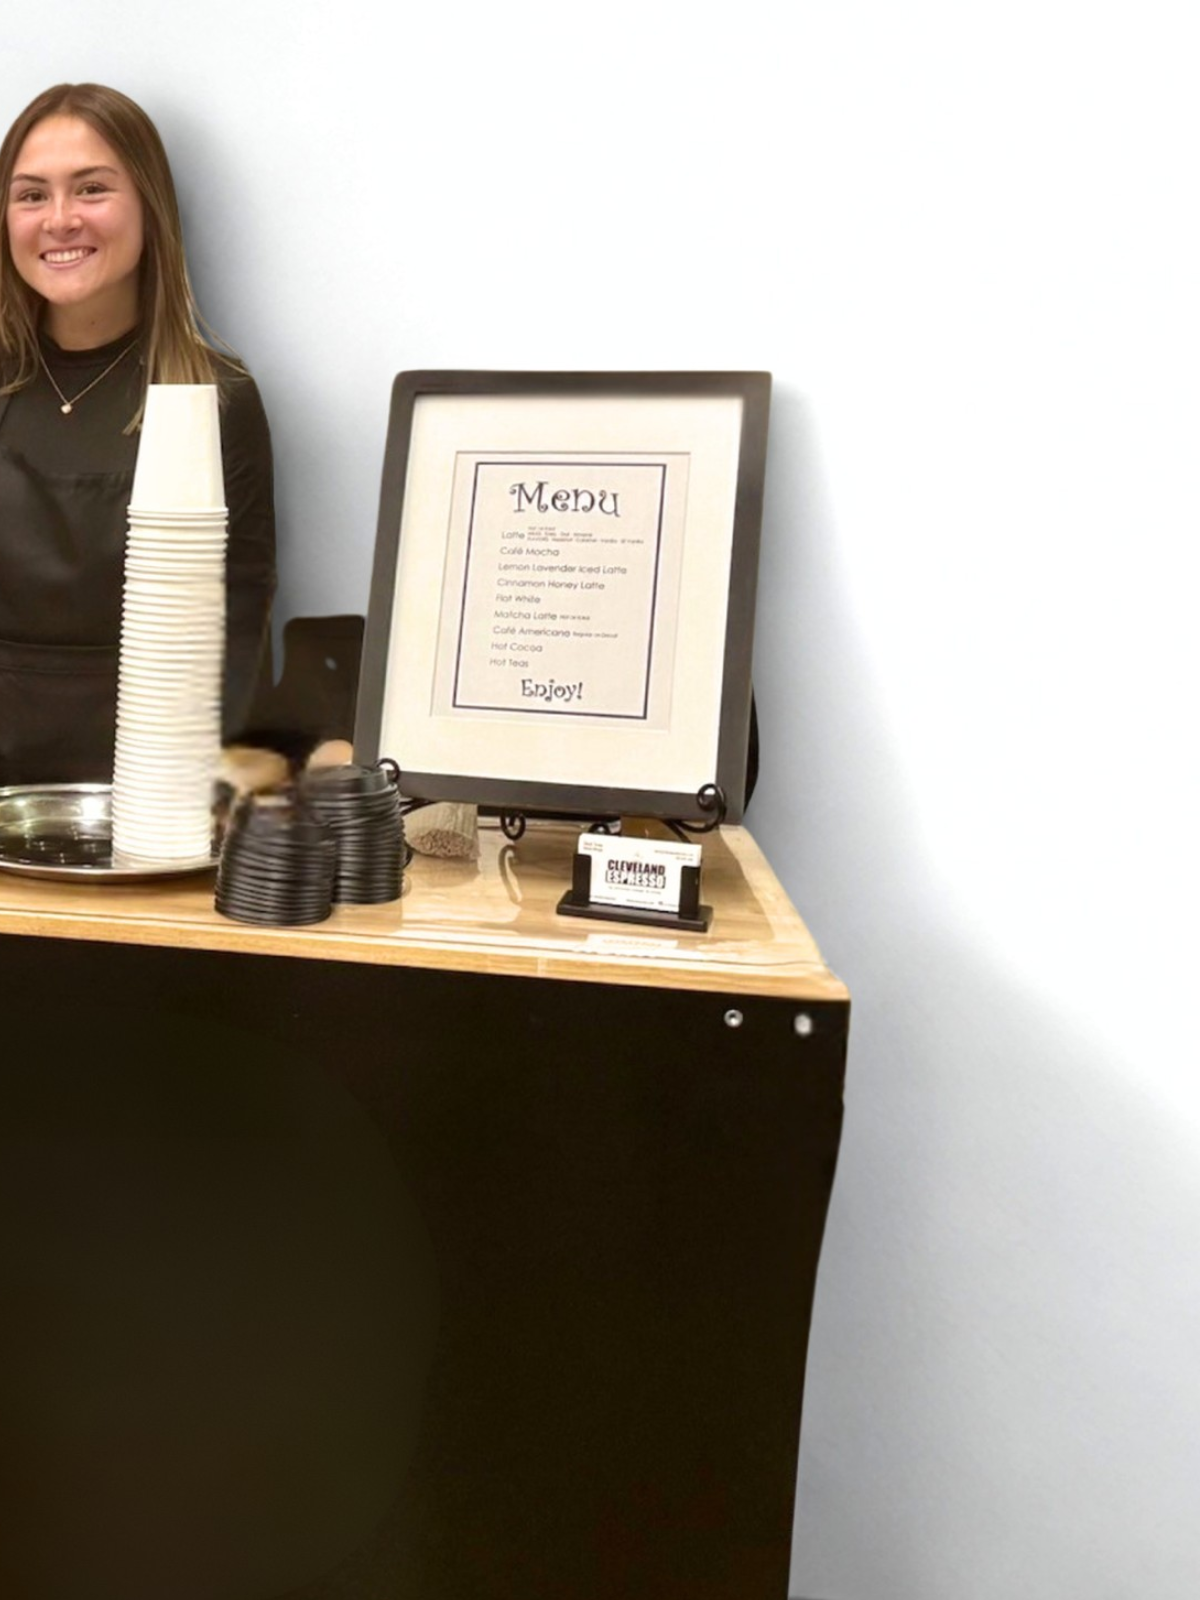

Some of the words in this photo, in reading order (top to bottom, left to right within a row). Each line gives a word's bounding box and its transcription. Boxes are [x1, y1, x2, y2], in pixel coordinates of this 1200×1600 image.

[509, 481, 621, 518] Menu
[501, 531, 525, 540] Latte
[500, 546, 523, 555] Café
[525, 548, 560, 556] Mocha
[498, 563, 530, 571] Lemon
[532, 564, 576, 573] Lavender
[578, 565, 600, 574] Iced
[602, 566, 627, 574] Latte
[497, 578, 546, 588] Cinnamon
[548, 580, 578, 590] Honey
[580, 581, 605, 590] Latte
[495, 594, 512, 603] Flat
[515, 595, 541, 604] White
[493, 610, 531, 620] Matcha
[533, 612, 557, 621] Latte
[492, 625, 516, 635] Café
[518, 627, 570, 637] Americano
[490, 642, 508, 650] Hot
[509, 643, 543, 652] Cocoa
[489, 658, 506, 666] Hot
[508, 659, 529, 668] Teas
[521, 678, 584, 702] Enjoy!
[607, 859, 666, 876] CLEVELAND
[606, 870, 666, 889] ESPRESSO
